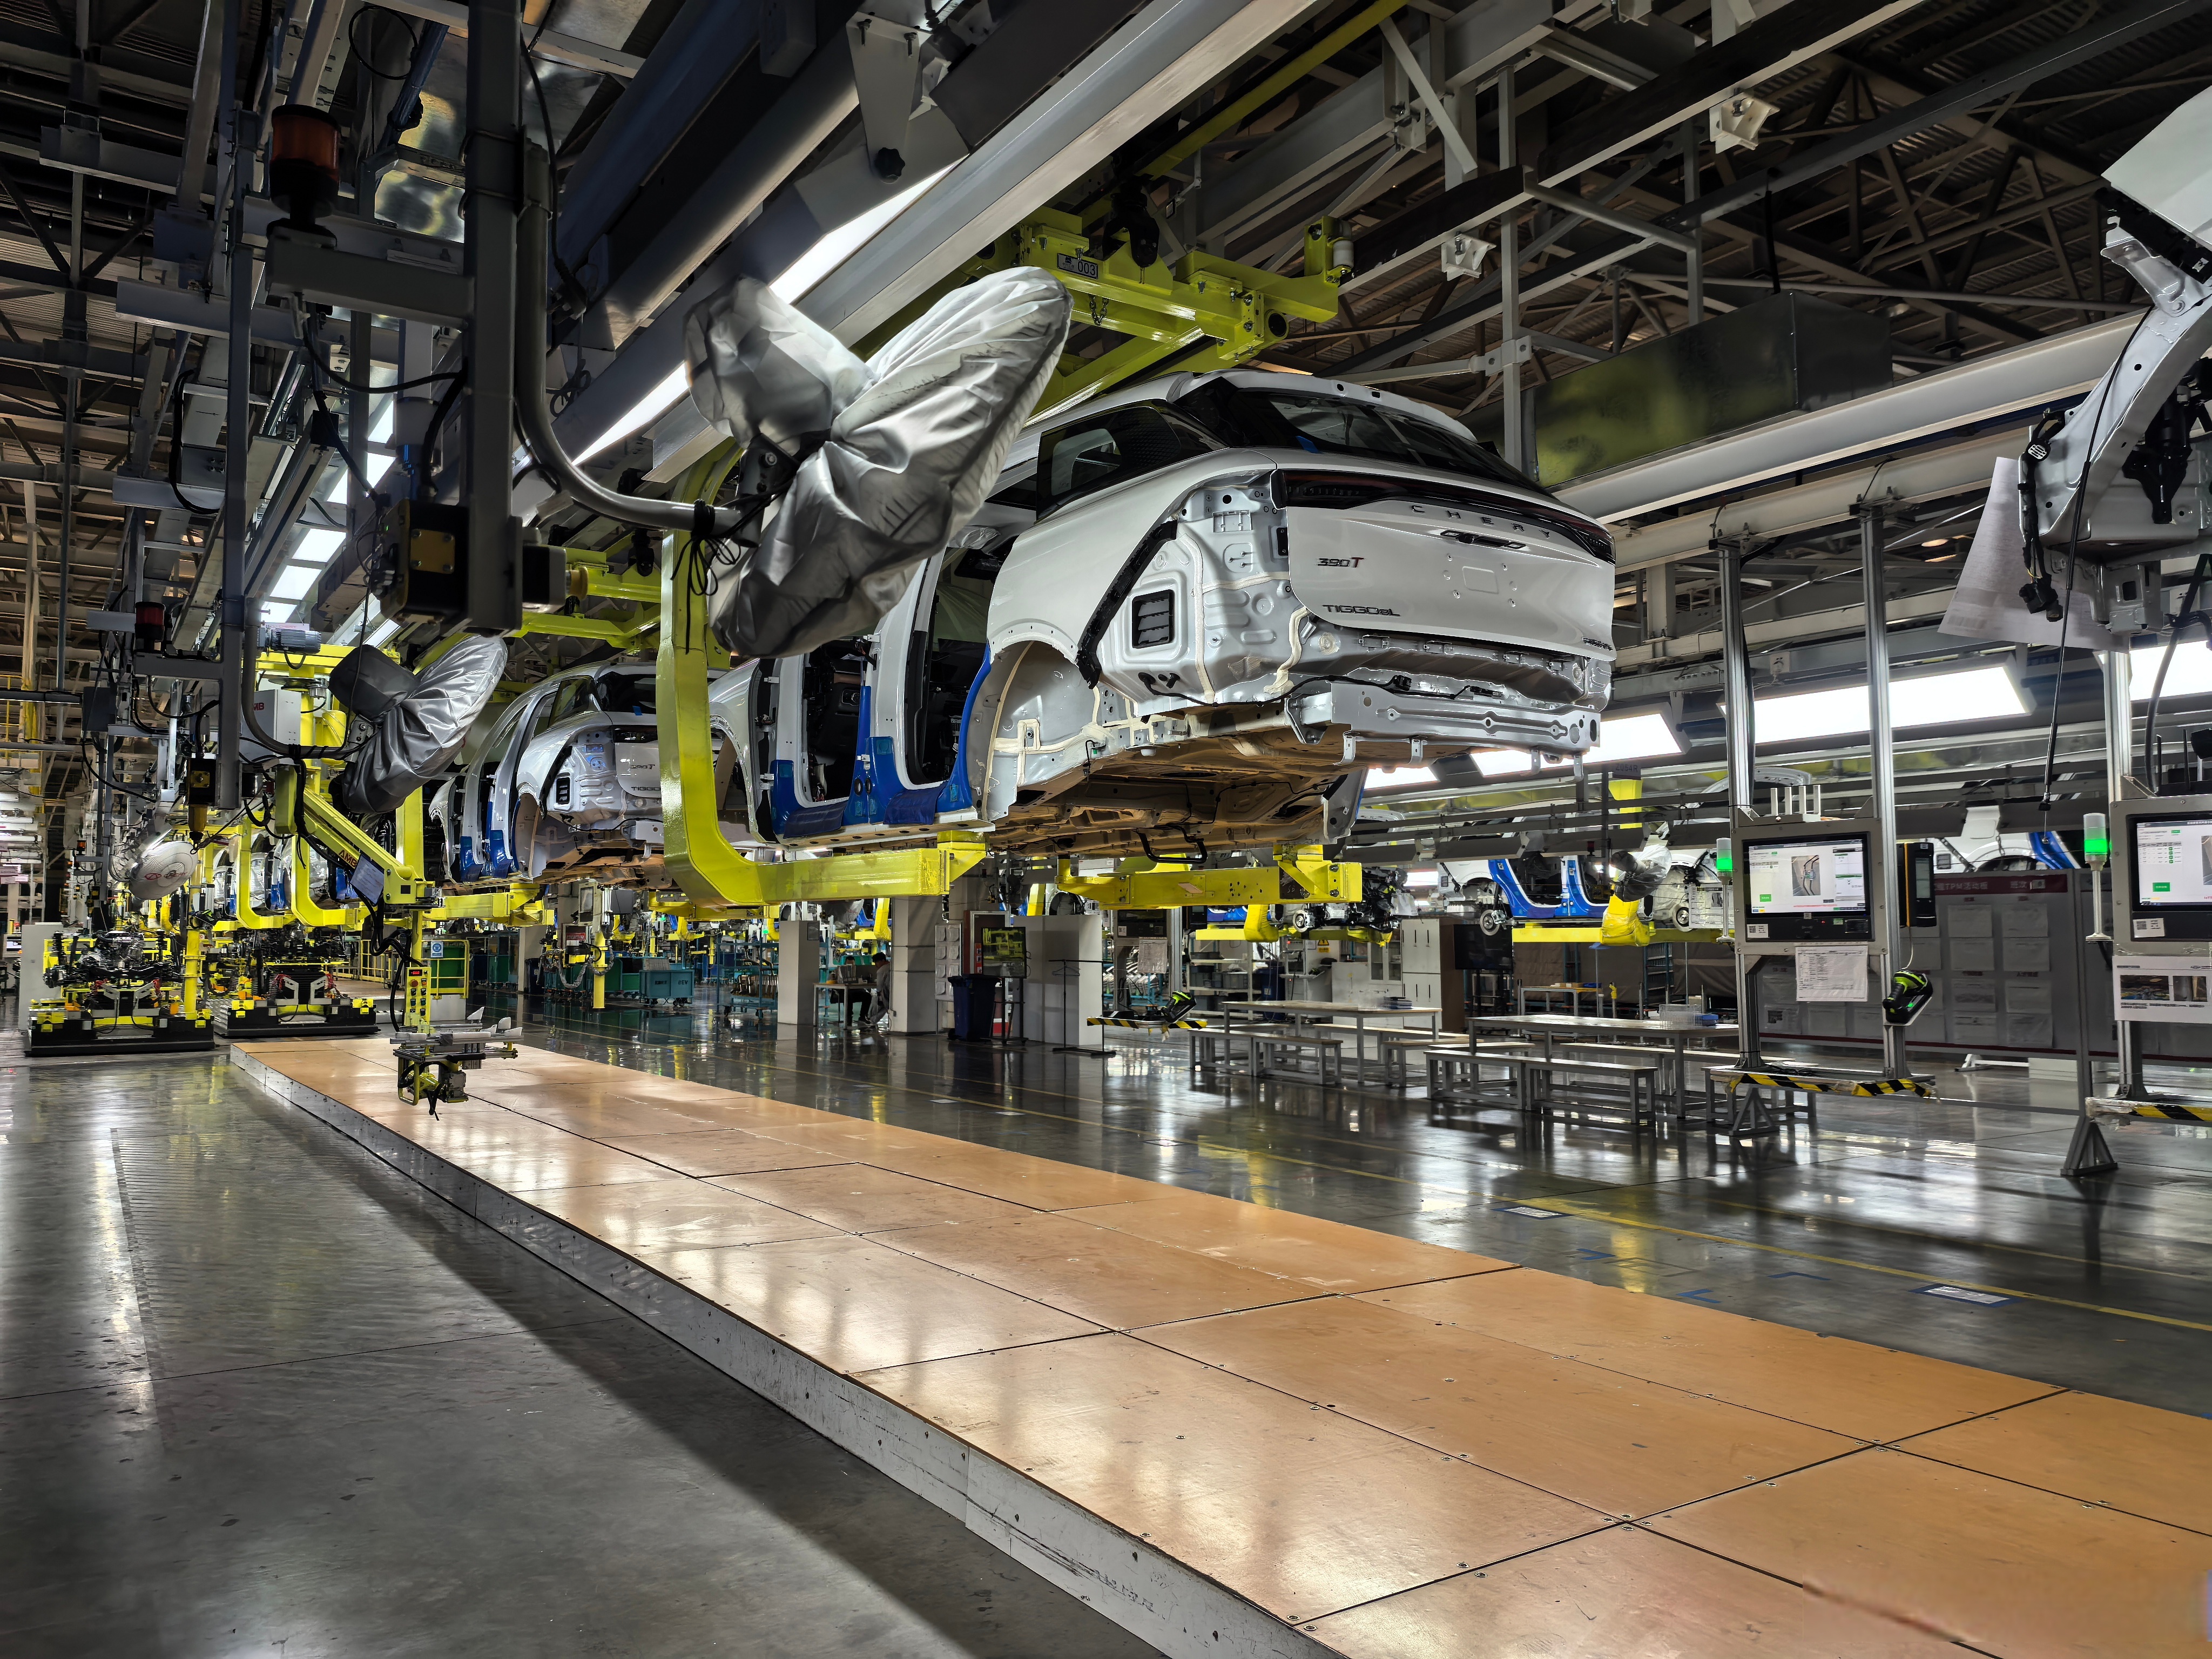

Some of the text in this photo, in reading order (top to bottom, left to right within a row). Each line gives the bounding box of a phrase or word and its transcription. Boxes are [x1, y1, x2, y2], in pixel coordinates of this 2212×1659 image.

[1078, 261, 1095, 275] 003
[1411, 505, 1550, 538] CHERY
[1317, 557, 1365, 568] 390T
[1321, 604, 1401, 616] TIGGO8L
[253, 703, 264, 711] MB
